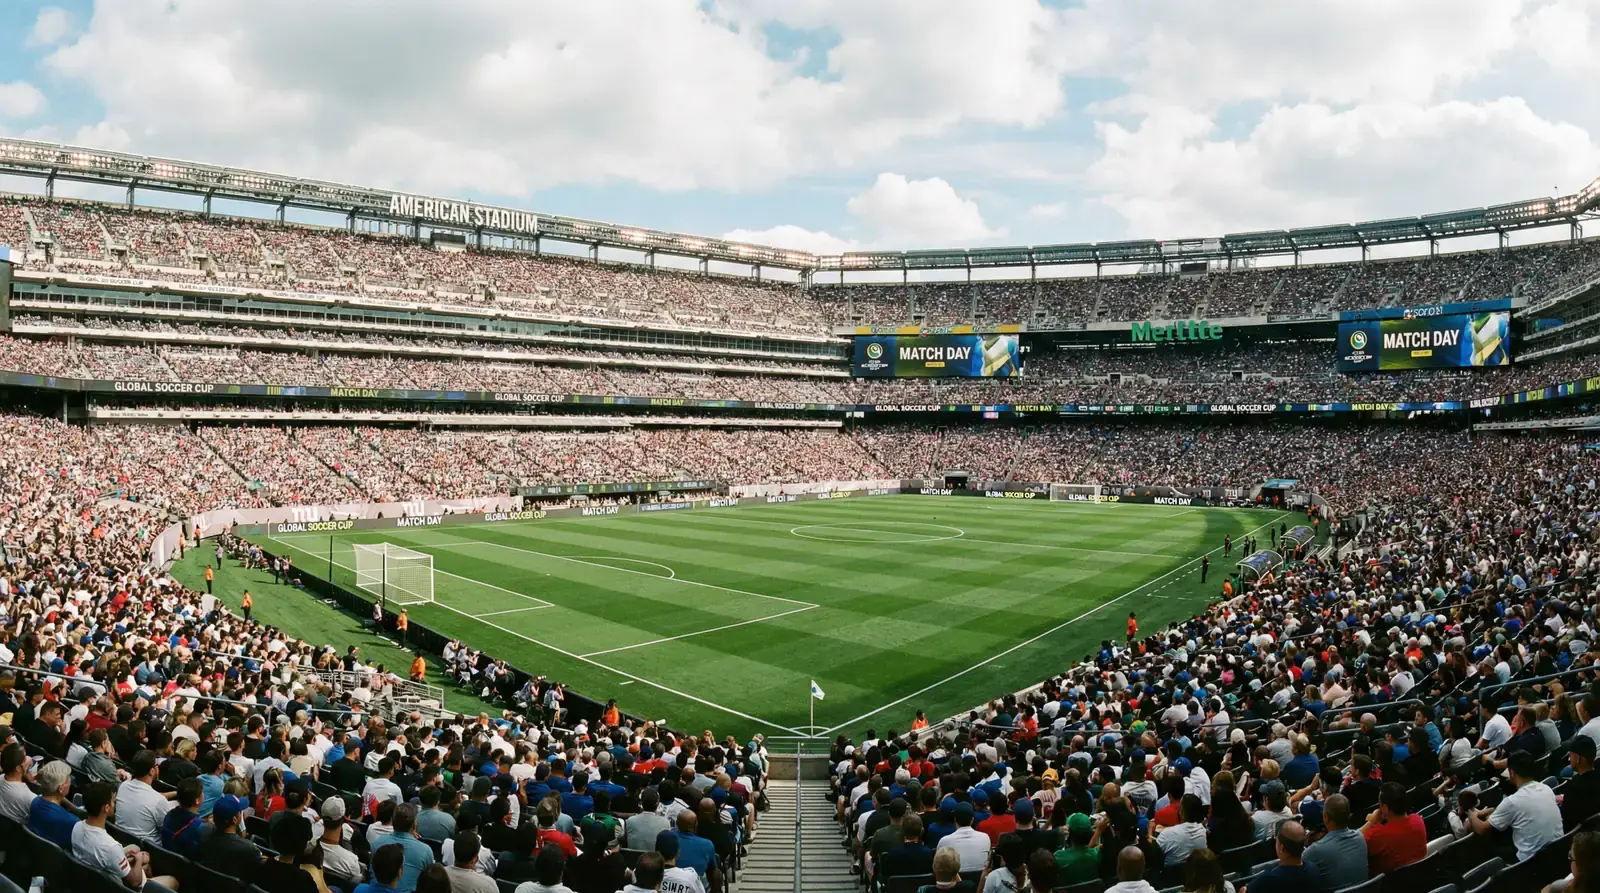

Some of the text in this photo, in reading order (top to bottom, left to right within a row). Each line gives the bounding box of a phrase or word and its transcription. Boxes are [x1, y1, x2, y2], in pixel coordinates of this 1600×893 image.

[389, 194, 538, 234] AMERICAN STADIUM
[1383, 329, 1460, 349] MATCH DAY
[899, 346, 971, 361] MATCH DAY
[114, 381, 214, 394] GLOBAL SOCCER CUP
[330, 387, 379, 398] MATCH DAY
[494, 392, 565, 403] GLOBAL SOCCER CUP
[1210, 404, 1235, 412] GLOBAL
[1263, 404, 1277, 412] CUP
[1154, 497, 1192, 506] MATCH DAY
[582, 506, 619, 516] MATCH DAY
[278, 520, 354, 533] GLOBAL SOCCER CUP
[397, 515, 442, 527] MATCH DAY
